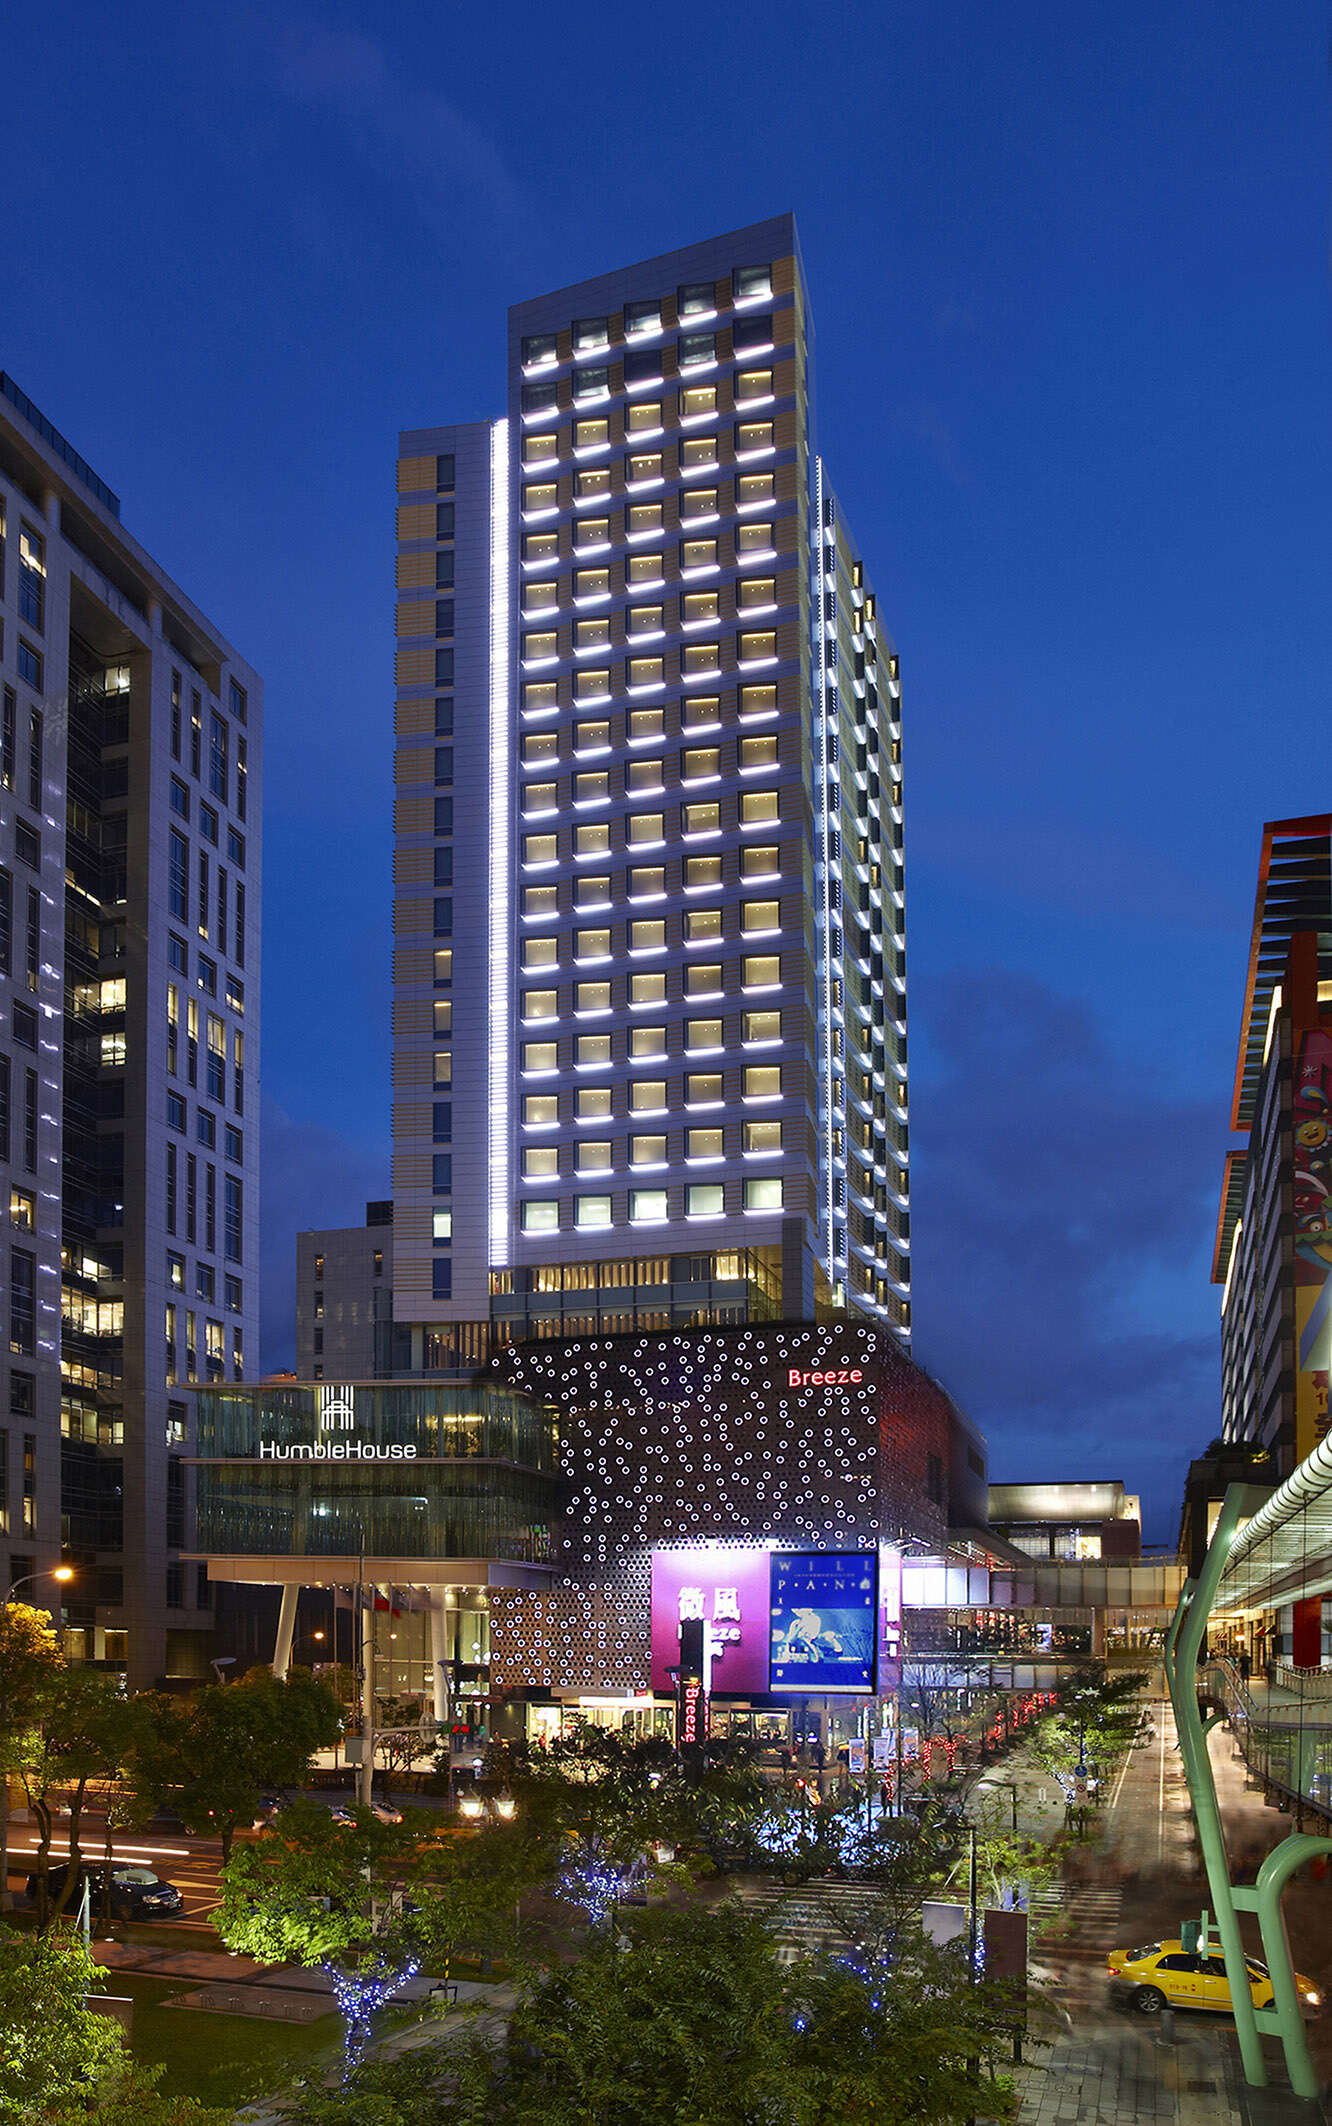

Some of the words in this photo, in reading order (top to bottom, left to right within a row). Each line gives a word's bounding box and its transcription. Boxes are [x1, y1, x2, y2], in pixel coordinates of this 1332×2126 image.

[788, 1368, 863, 1387] Breeze
[259, 1439, 417, 1459] HumbleHouse
[685, 1686, 699, 1742] Breeze
